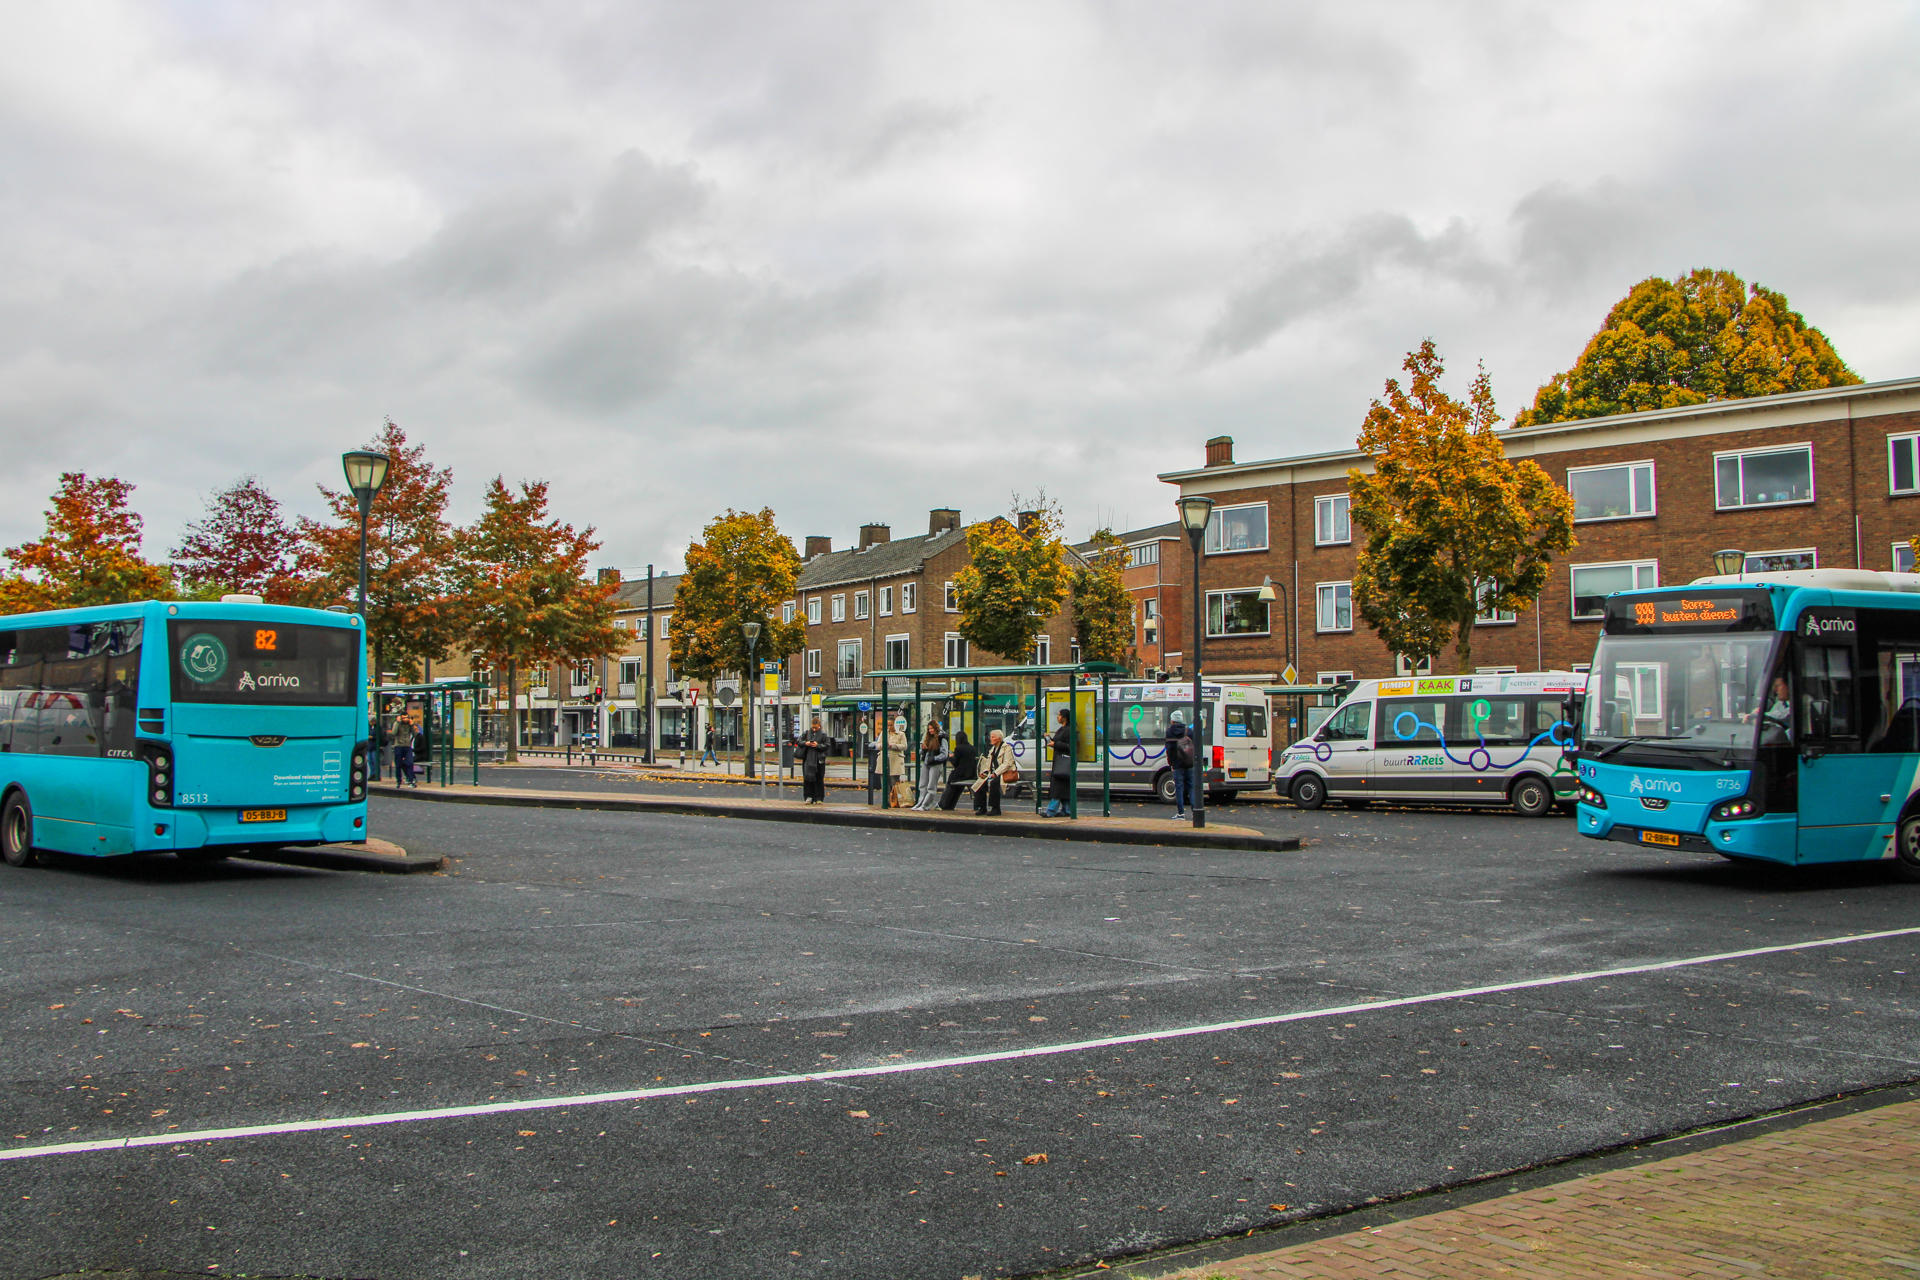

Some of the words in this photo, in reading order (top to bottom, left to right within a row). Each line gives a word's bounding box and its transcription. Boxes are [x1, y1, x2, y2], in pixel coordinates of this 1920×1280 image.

[1681, 599, 1715, 610] Sorry,
[1662, 610, 1699, 622] buiten
[1700, 608, 1737, 621] dienst
[1820, 616, 1856, 631] arriva
[255, 629, 277, 650] 82
[257, 673, 300, 688] arriva
[1382, 681, 1411, 690] JUMBO
[1418, 680, 1452, 690] KAAK
[107, 749, 134, 758] CITEA
[1383, 753, 1445, 767] buurtRRReis
[1645, 777, 1682, 793] arriva
[1715, 778, 1741, 790] 8736
[182, 793, 209, 804] 8513
[1643, 798, 1665, 807] VDL
[245, 810, 284, 820] 05-BBJ-8
